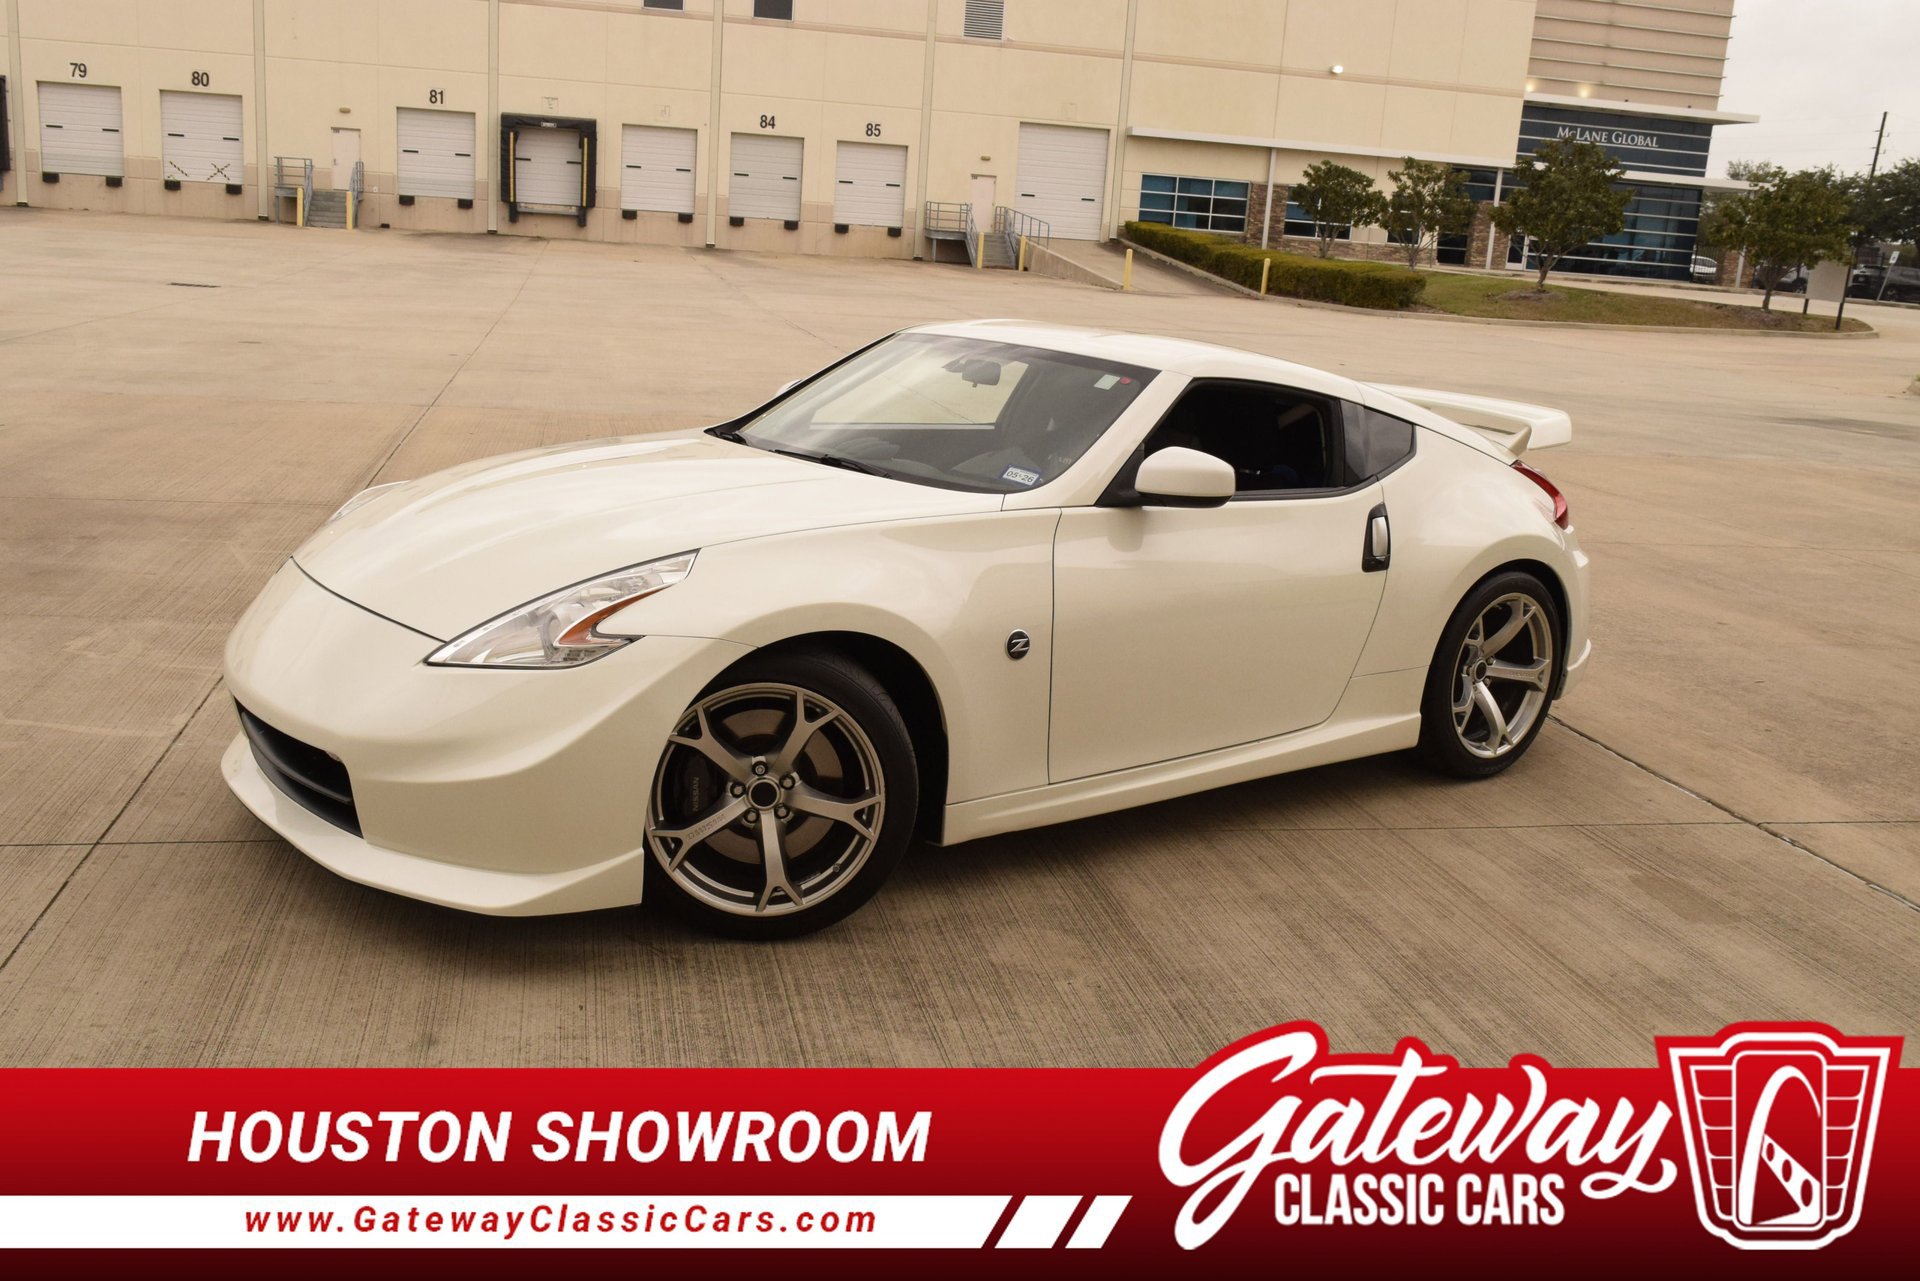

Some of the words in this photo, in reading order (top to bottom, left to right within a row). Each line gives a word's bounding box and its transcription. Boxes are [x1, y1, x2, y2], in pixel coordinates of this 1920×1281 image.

[70, 62, 87, 78] 79
[191, 71, 210, 88] 80
[429, 89, 444, 105] 81
[759, 115, 776, 130] 84
[865, 123, 882, 138] 85
